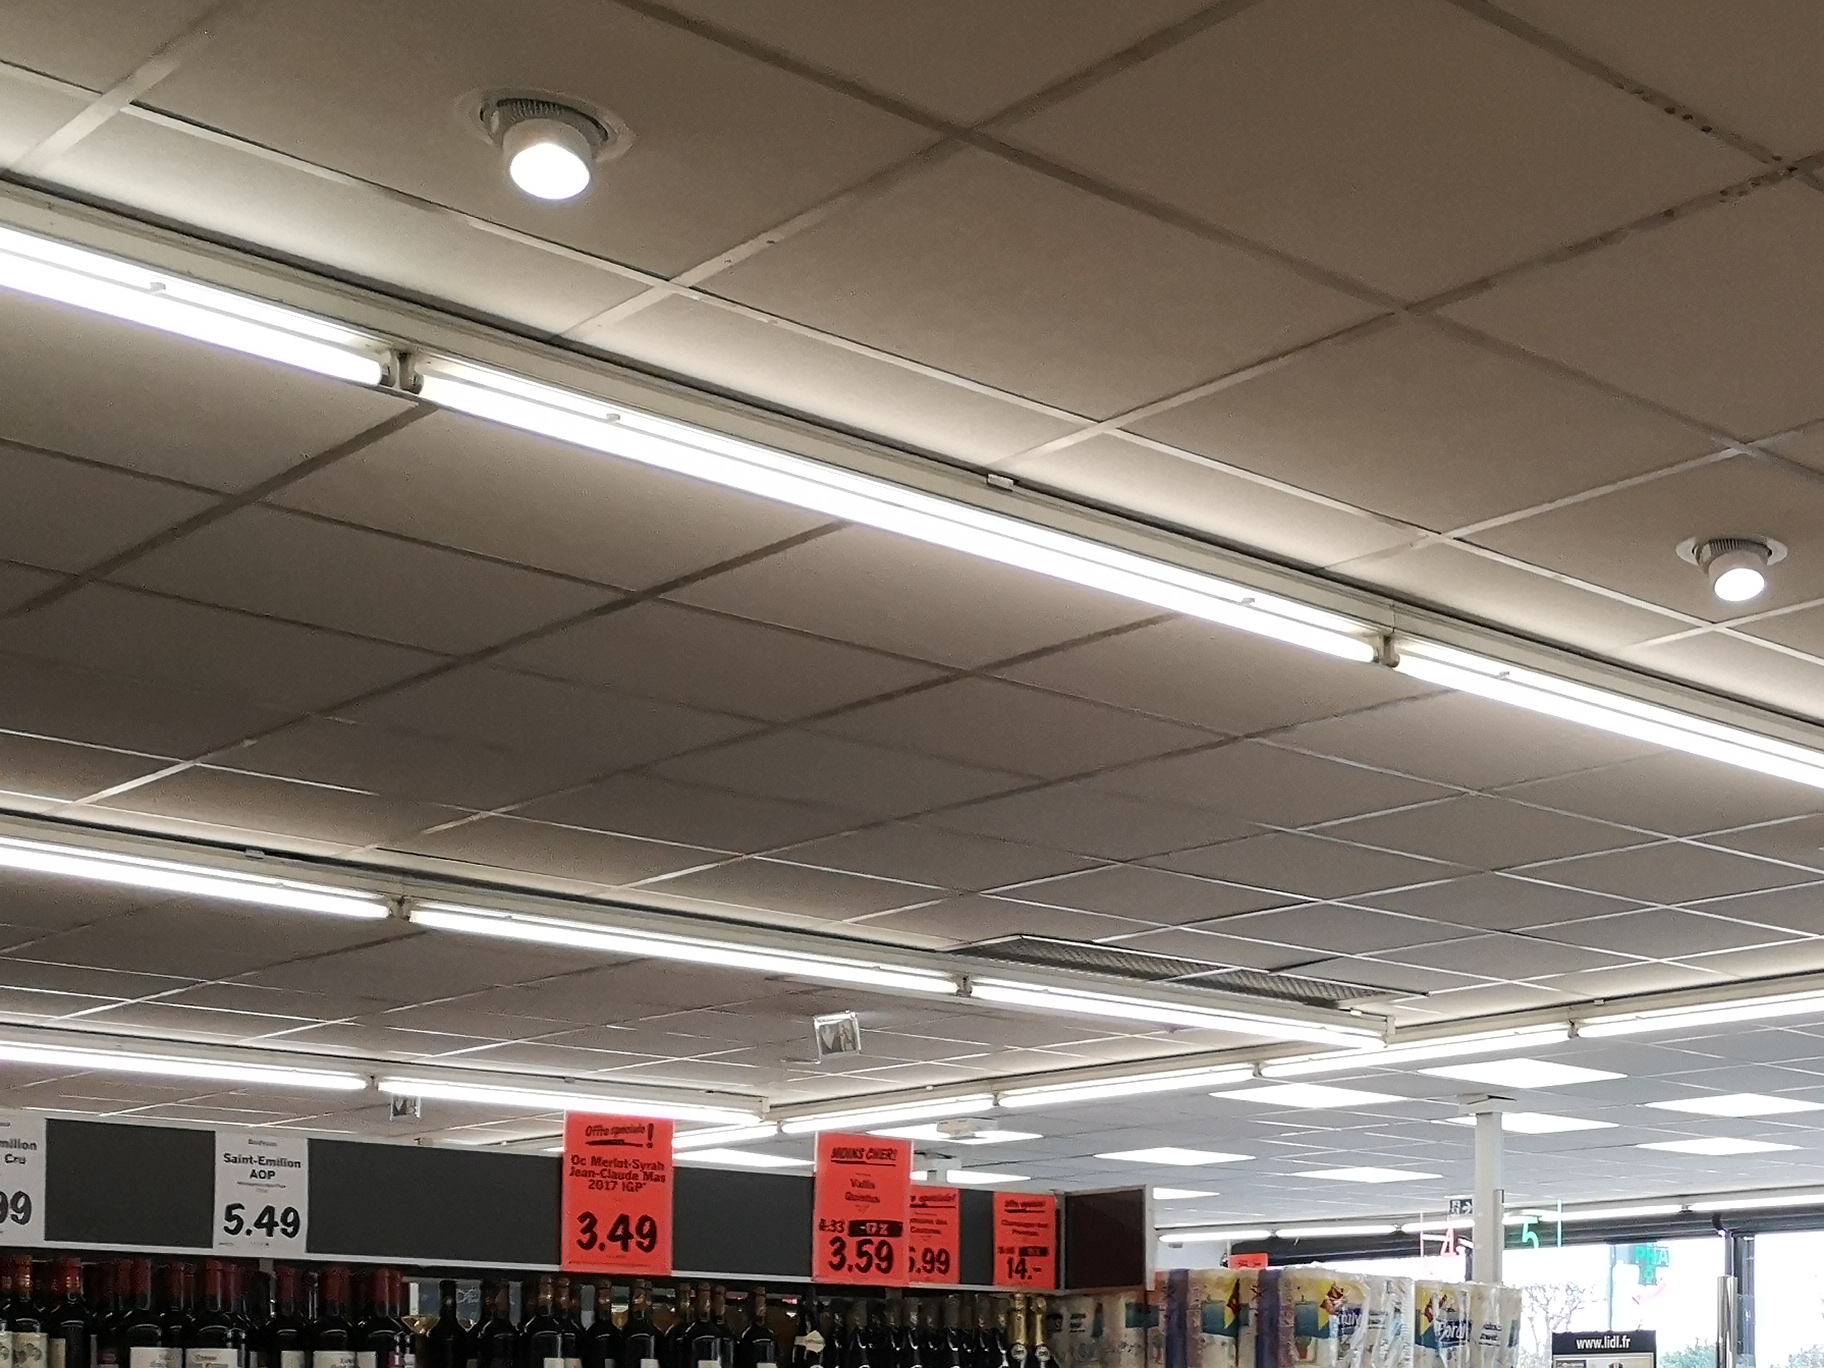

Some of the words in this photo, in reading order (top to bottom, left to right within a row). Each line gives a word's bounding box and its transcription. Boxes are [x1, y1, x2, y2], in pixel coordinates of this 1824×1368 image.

[250, 1169, 276, 1180] AOP
[569, 1166, 639, 1181] Jean-Claude
[588, 1179, 618, 1191] 2017
[223, 1202, 300, 1238] 5.49
[576, 1211, 658, 1253] 3.49
[828, 1236, 894, 1275] 3.59
[1576, 1335, 1631, 1350] www.lidl.fr
